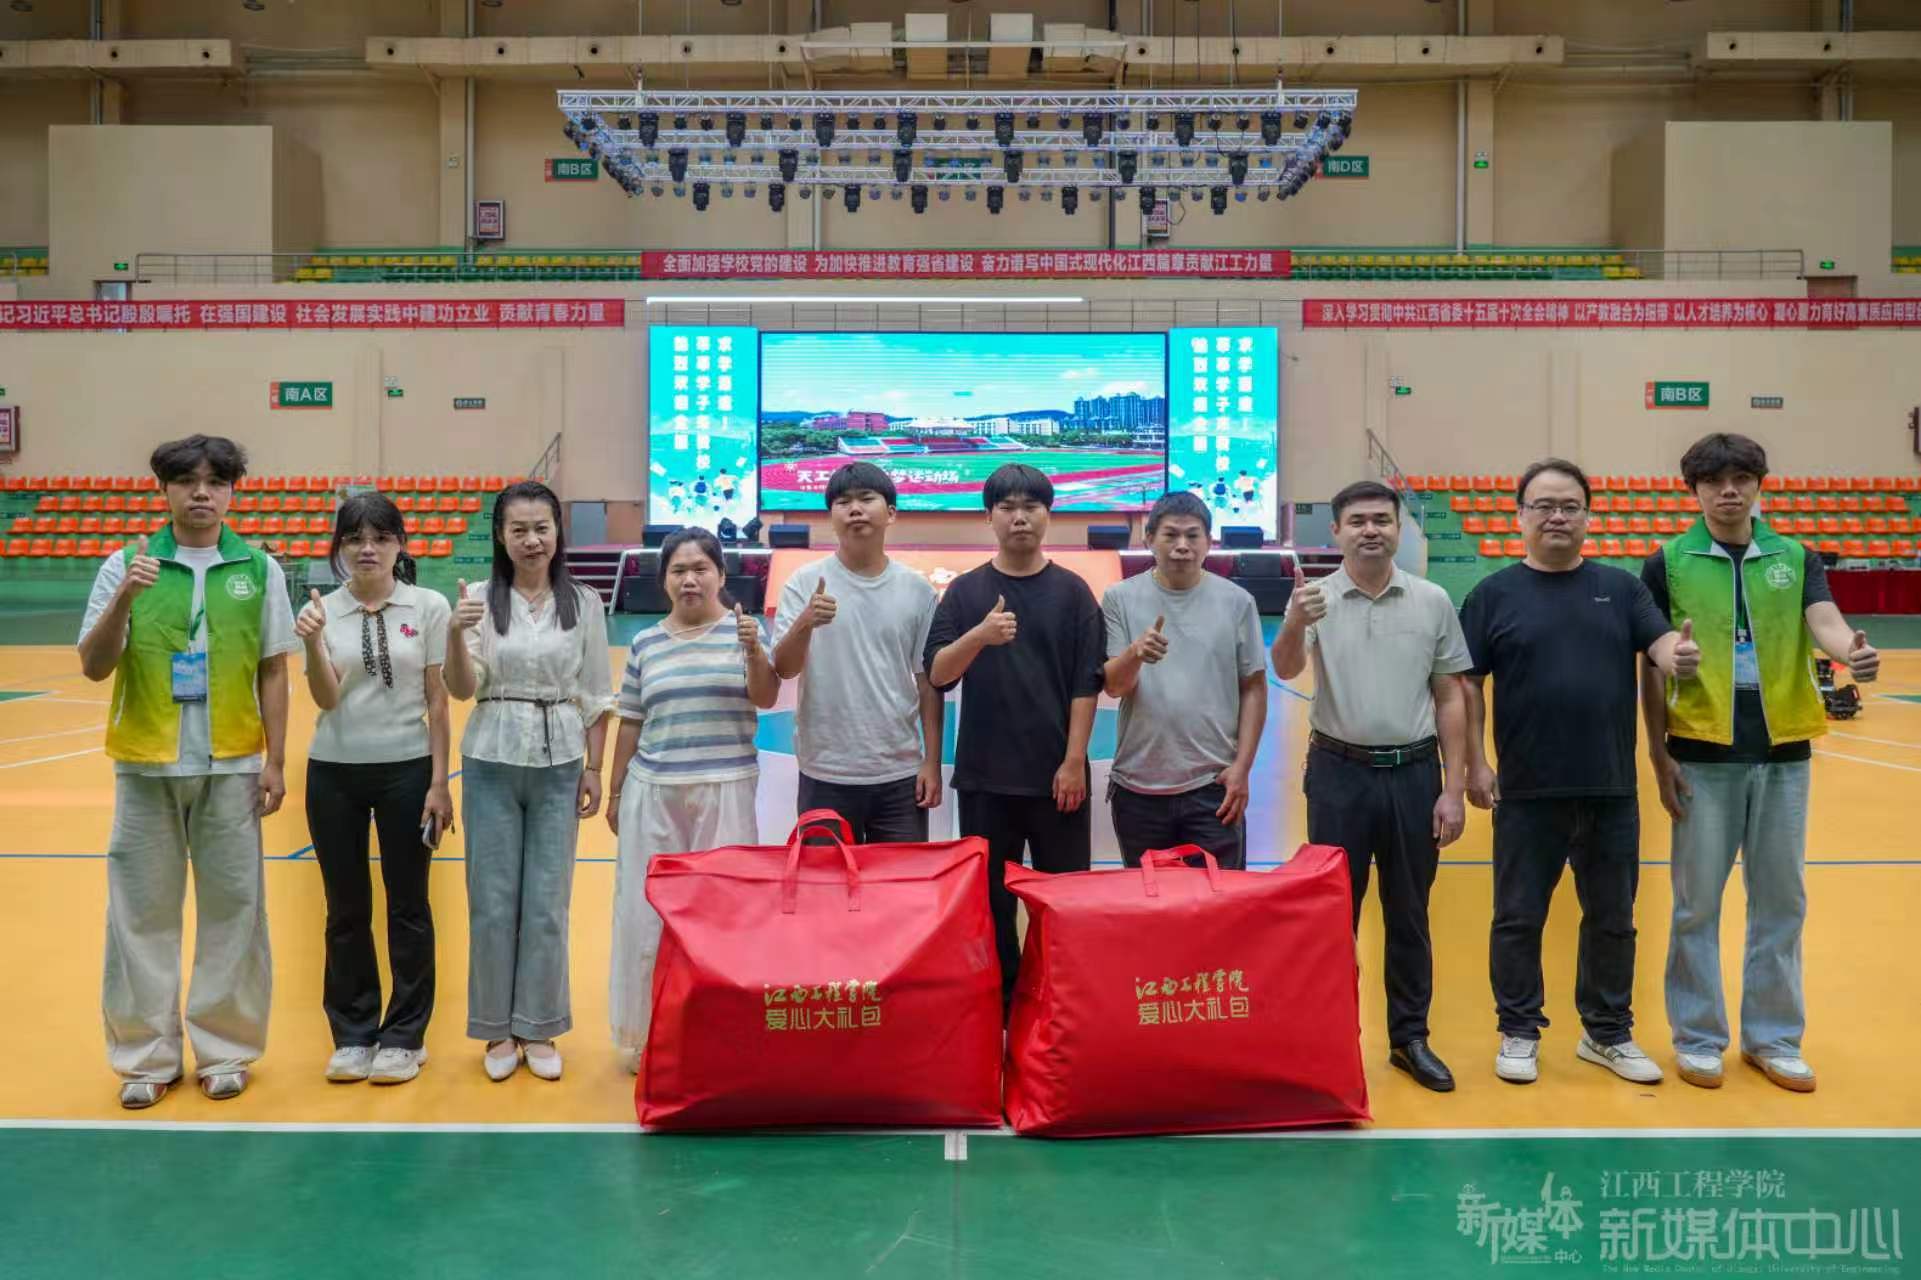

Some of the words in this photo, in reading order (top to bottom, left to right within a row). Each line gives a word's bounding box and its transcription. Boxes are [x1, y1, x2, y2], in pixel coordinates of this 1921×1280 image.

[557, 162, 593, 176] 南B区
[1328, 159, 1364, 173] 南D区
[663, 253, 807, 273] 全面加强学校党的建设
[815, 253, 974, 273] 为加快推进教育强省建设
[981, 253, 1273, 273] 奋力谱写中国式现代化江西篇章贡献江工力量
[200, 304, 288, 324] 在强国建设
[296, 303, 490, 323] 社会发展实践中建功立业
[500, 303, 605, 322] 贡献青春力量
[1322, 303, 1569, 323] 深入学习贯彻中共江西省委十五届十次全会精神
[1674, 302, 1768, 322] 以人才培养为核心
[285, 387, 328, 402] 南A区
[1661, 387, 1703, 402] 南B区
[765, 1005, 881, 1031] 爱心大礼包
[1138, 996, 1249, 1025] 爱心大礼包
